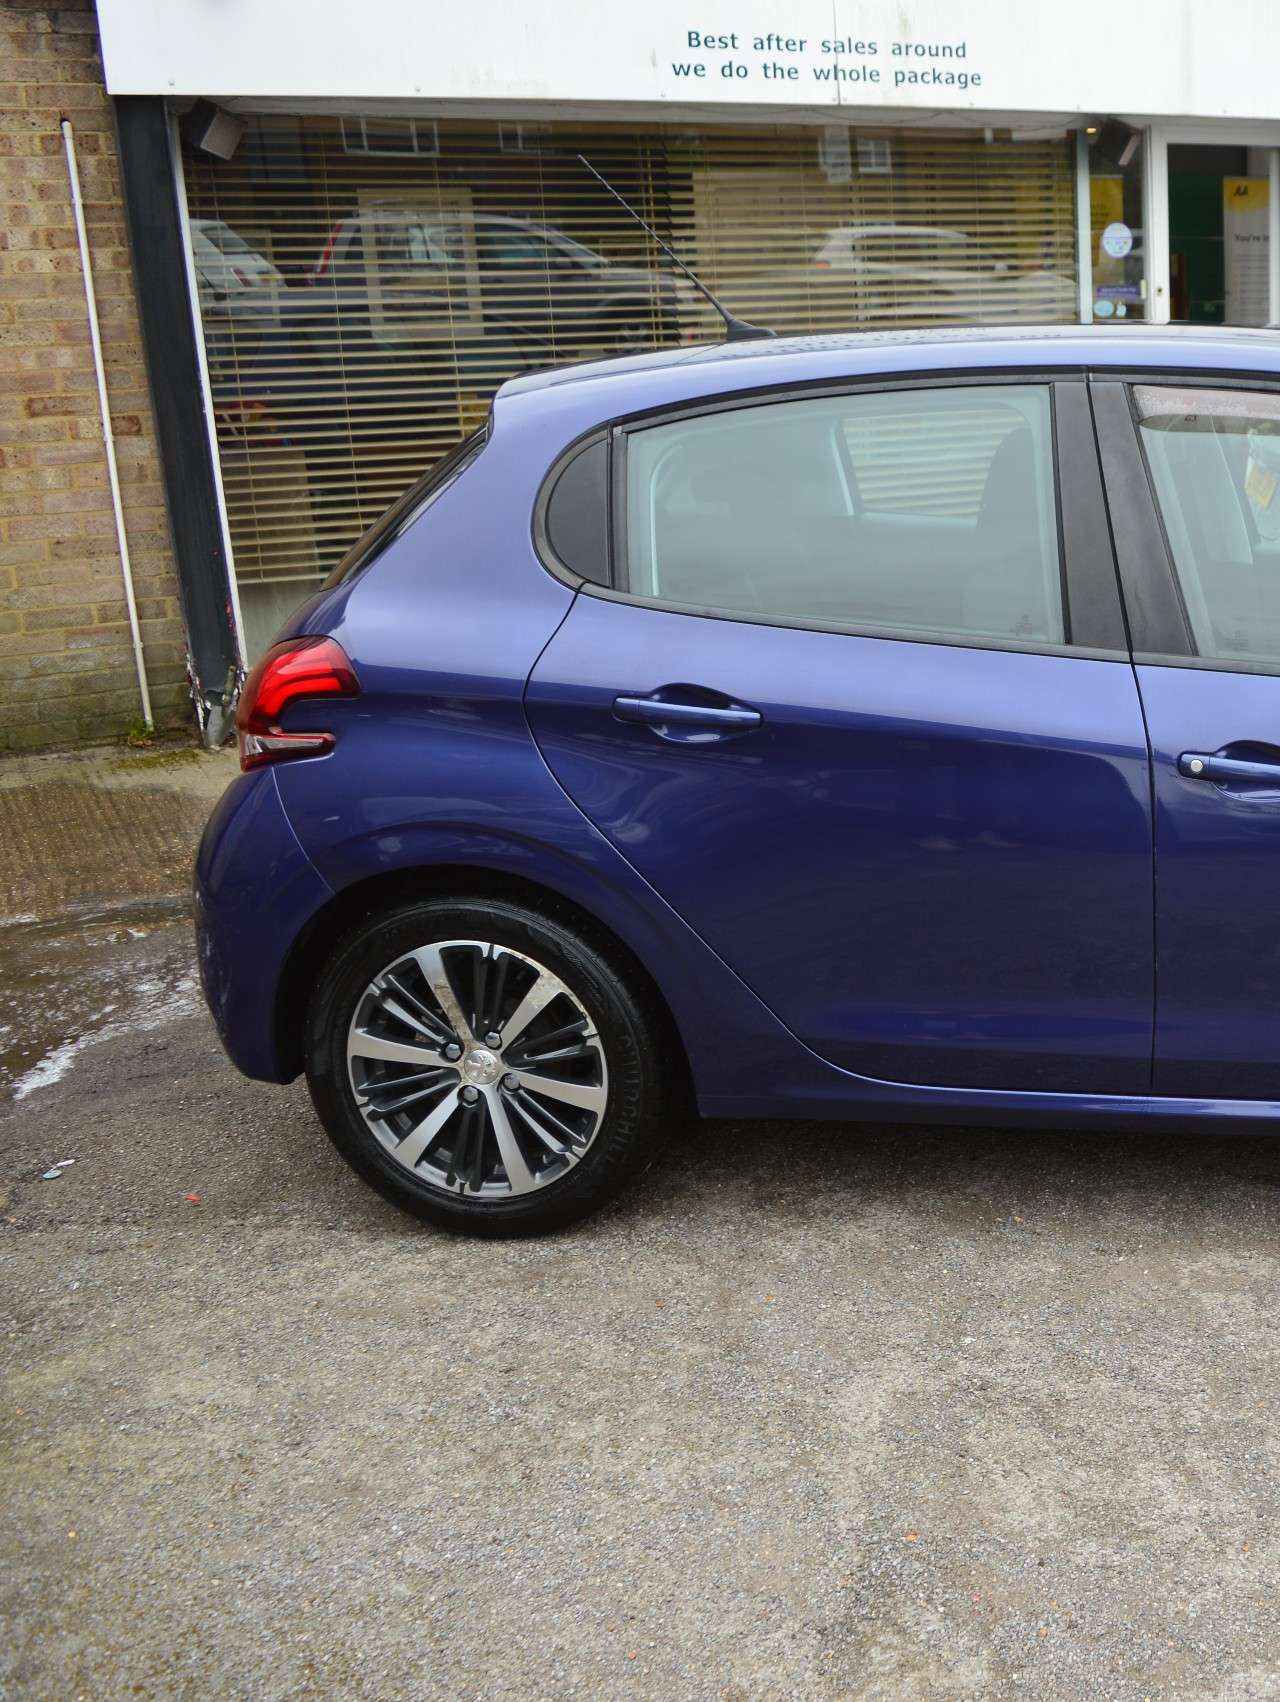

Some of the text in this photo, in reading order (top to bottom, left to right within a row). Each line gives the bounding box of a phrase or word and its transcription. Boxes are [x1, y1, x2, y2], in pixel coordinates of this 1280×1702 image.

[687, 31, 967, 58] Best after sales around
[672, 60, 982, 90] we do the whole package
